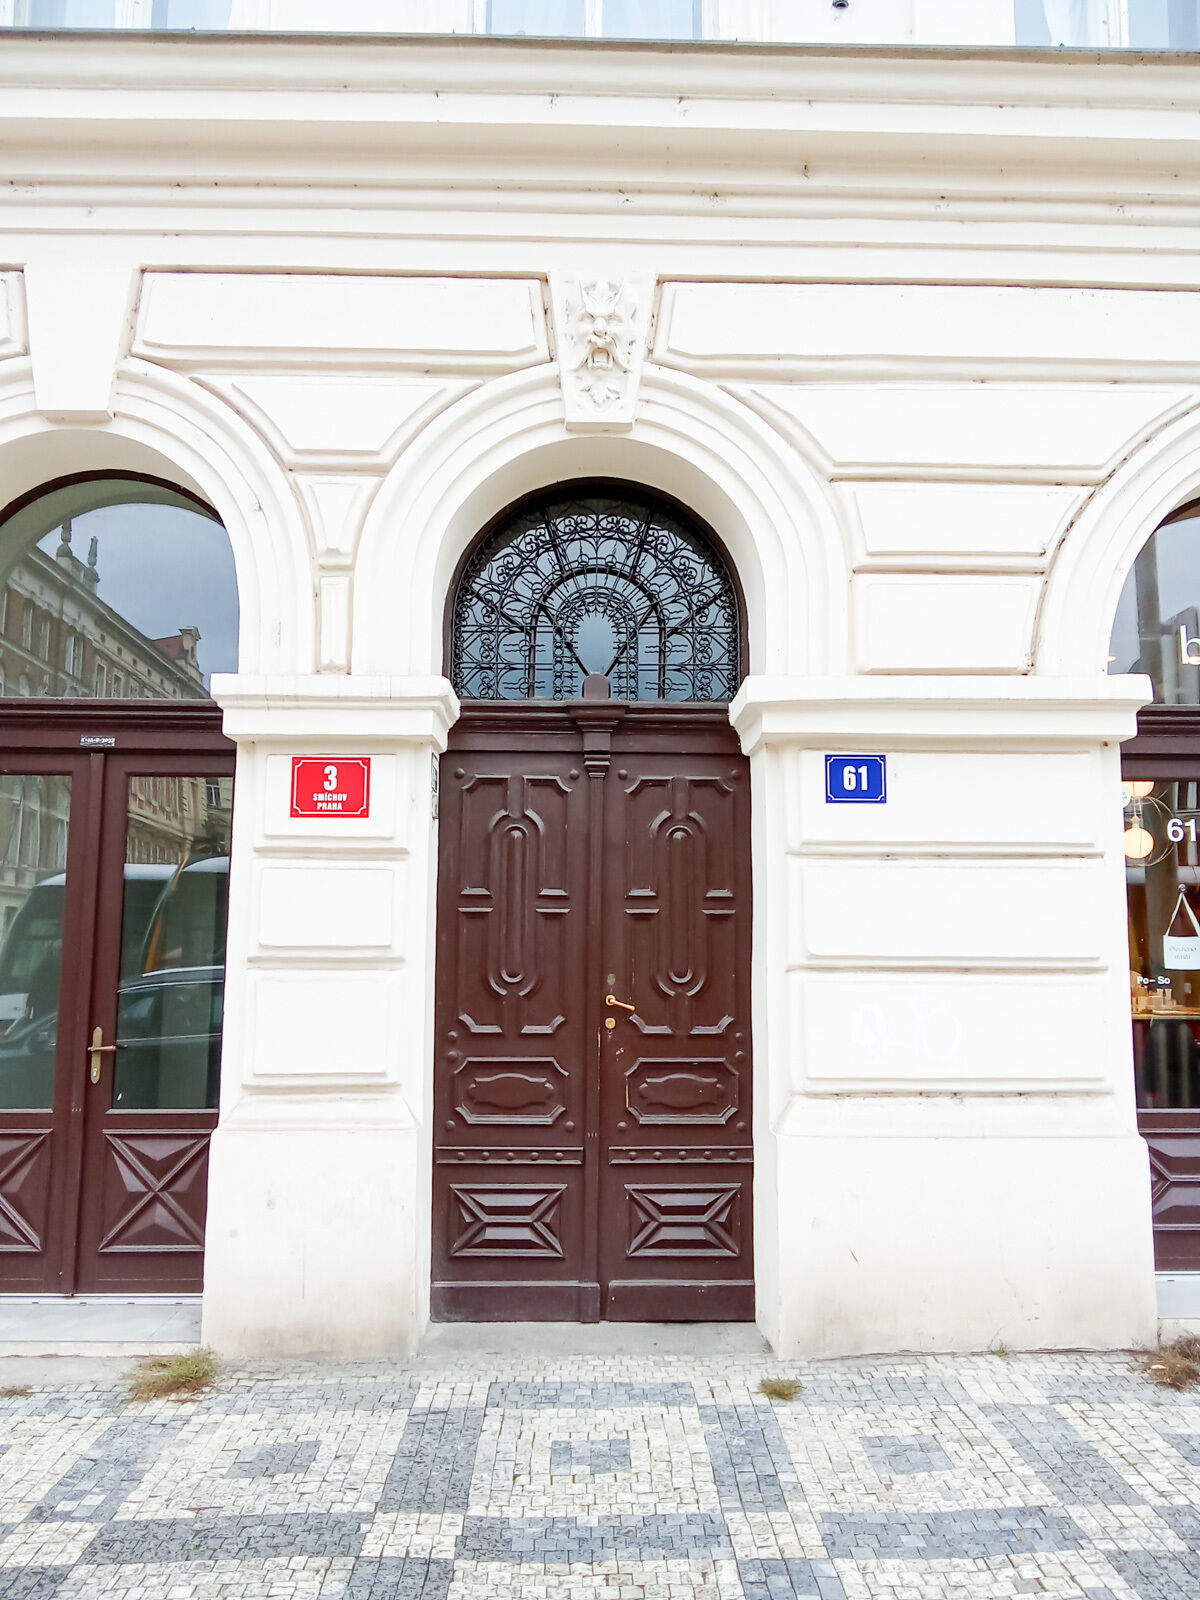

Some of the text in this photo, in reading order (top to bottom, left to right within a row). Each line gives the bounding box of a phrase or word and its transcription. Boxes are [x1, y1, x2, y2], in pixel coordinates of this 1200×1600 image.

[323, 765, 338, 791] 3
[843, 765, 868, 791] 61
[312, 792, 348, 801] SMÍCHOV
[317, 802, 343, 810] PRAHA
[1166, 818, 1197, 842] 61
[1157, 976, 1171, 985] So
